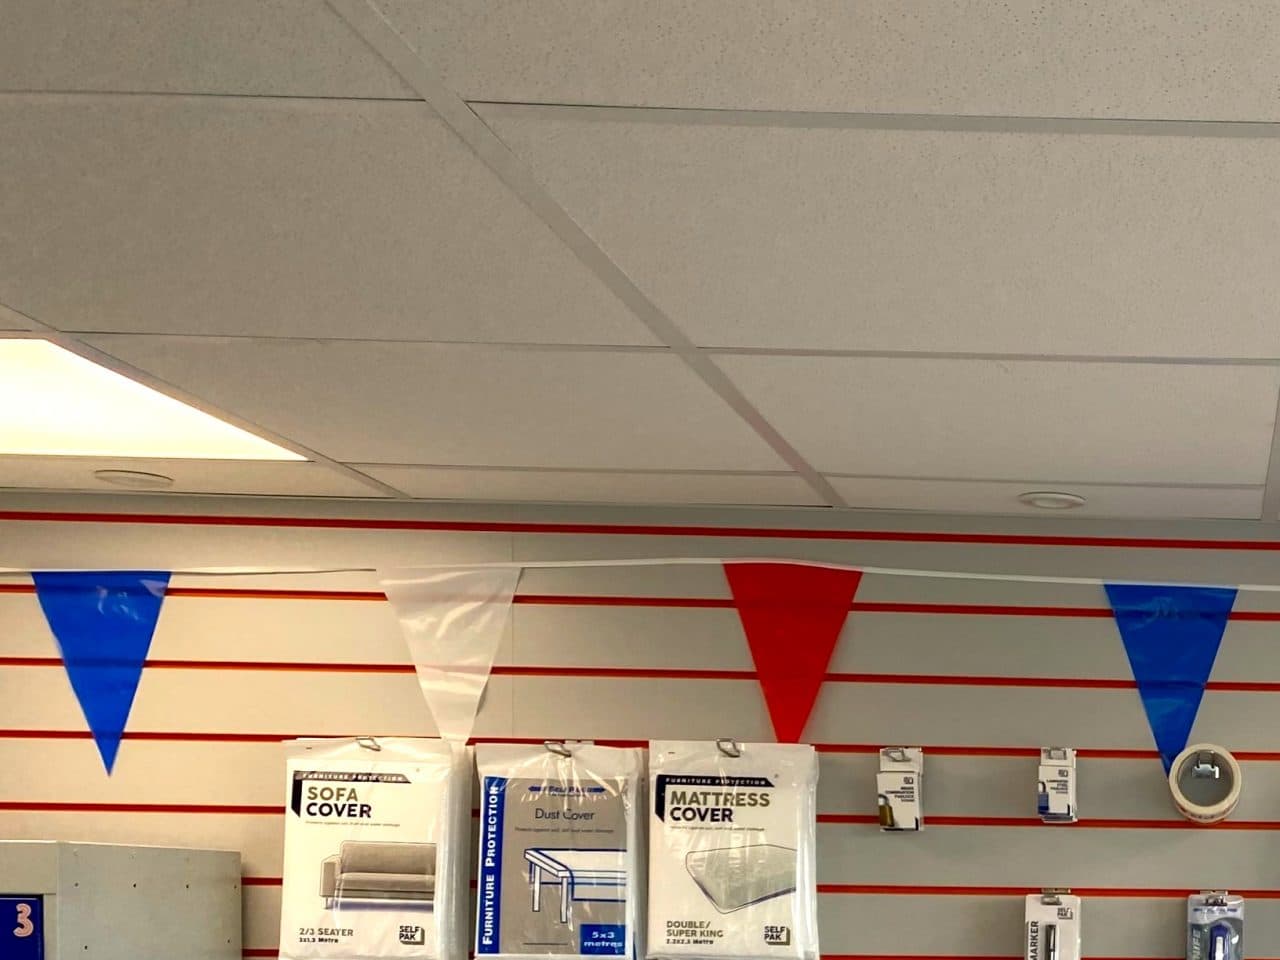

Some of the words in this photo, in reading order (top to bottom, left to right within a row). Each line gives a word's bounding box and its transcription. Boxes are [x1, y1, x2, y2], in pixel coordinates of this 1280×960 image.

[307, 786, 358, 801] SOFA
[670, 791, 770, 807] MATTRESS
[306, 802, 372, 818] COVER
[535, 808, 560, 820] Dust
[563, 809, 595, 820] Cover
[669, 807, 734, 822] COVER
[485, 786, 499, 868] PROTECTION
[482, 874, 495, 945] FURNITURE
[13, 903, 34, 937] 3
[666, 920, 711, 929] DOUBLE/
[299, 927, 315, 935] 2/3
[318, 927, 354, 936] SEATER
[666, 929, 697, 937] SUPER
[700, 930, 724, 938] KING
